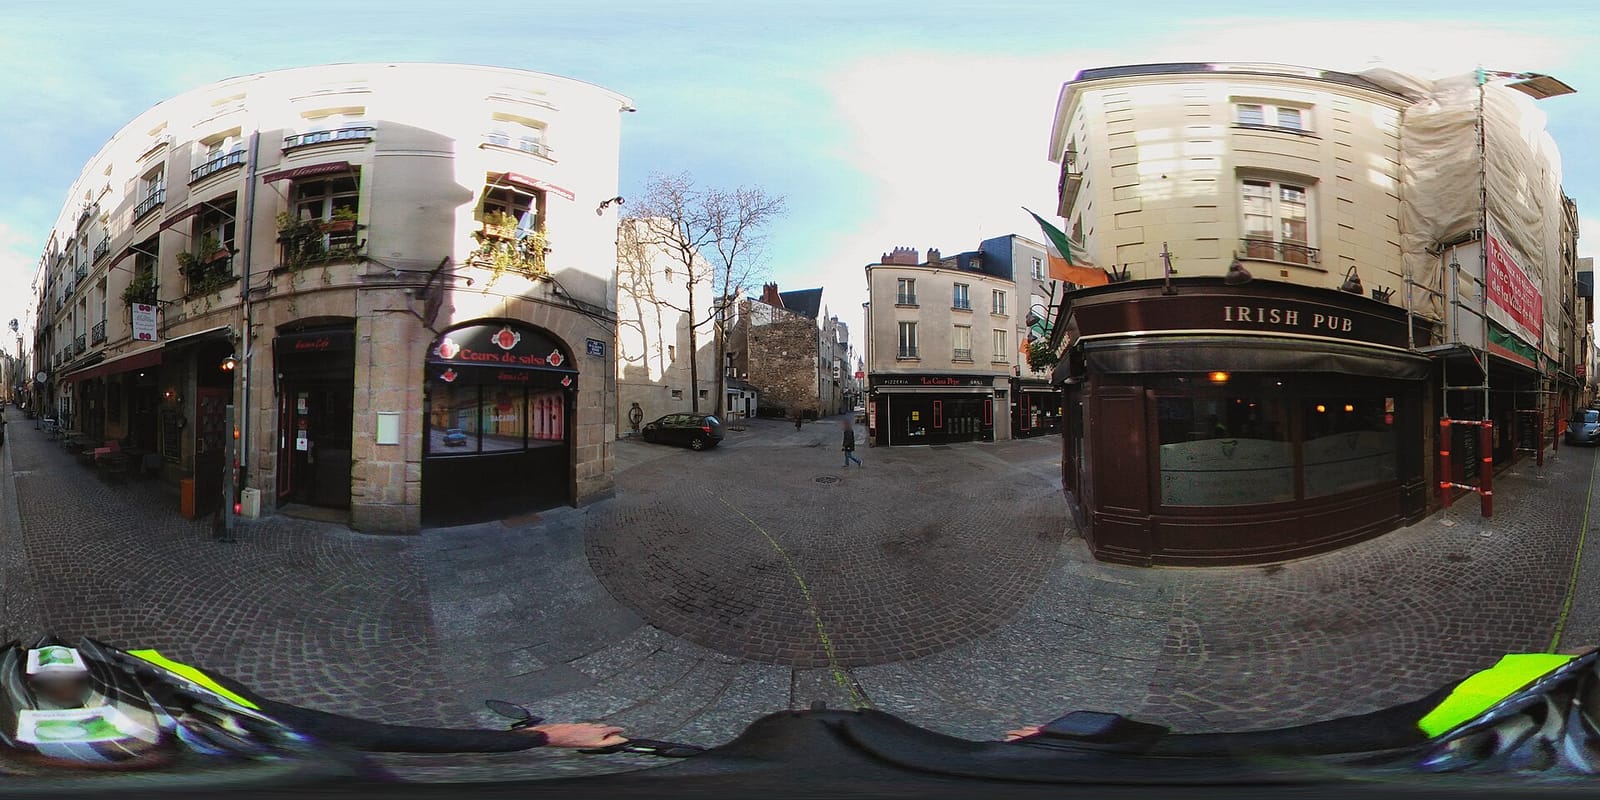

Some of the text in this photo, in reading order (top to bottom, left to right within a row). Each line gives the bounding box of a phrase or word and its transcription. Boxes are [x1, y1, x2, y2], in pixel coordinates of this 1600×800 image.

[1489, 240, 1515, 277] Travaux
[1490, 260, 1509, 284] avec
[1491, 277, 1500, 295] de
[1501, 285, 1509, 302] la
[1224, 306, 1353, 332] IRISH PUB
[460, 349, 545, 365] Cours de salsa
[921, 377, 931, 385] La
